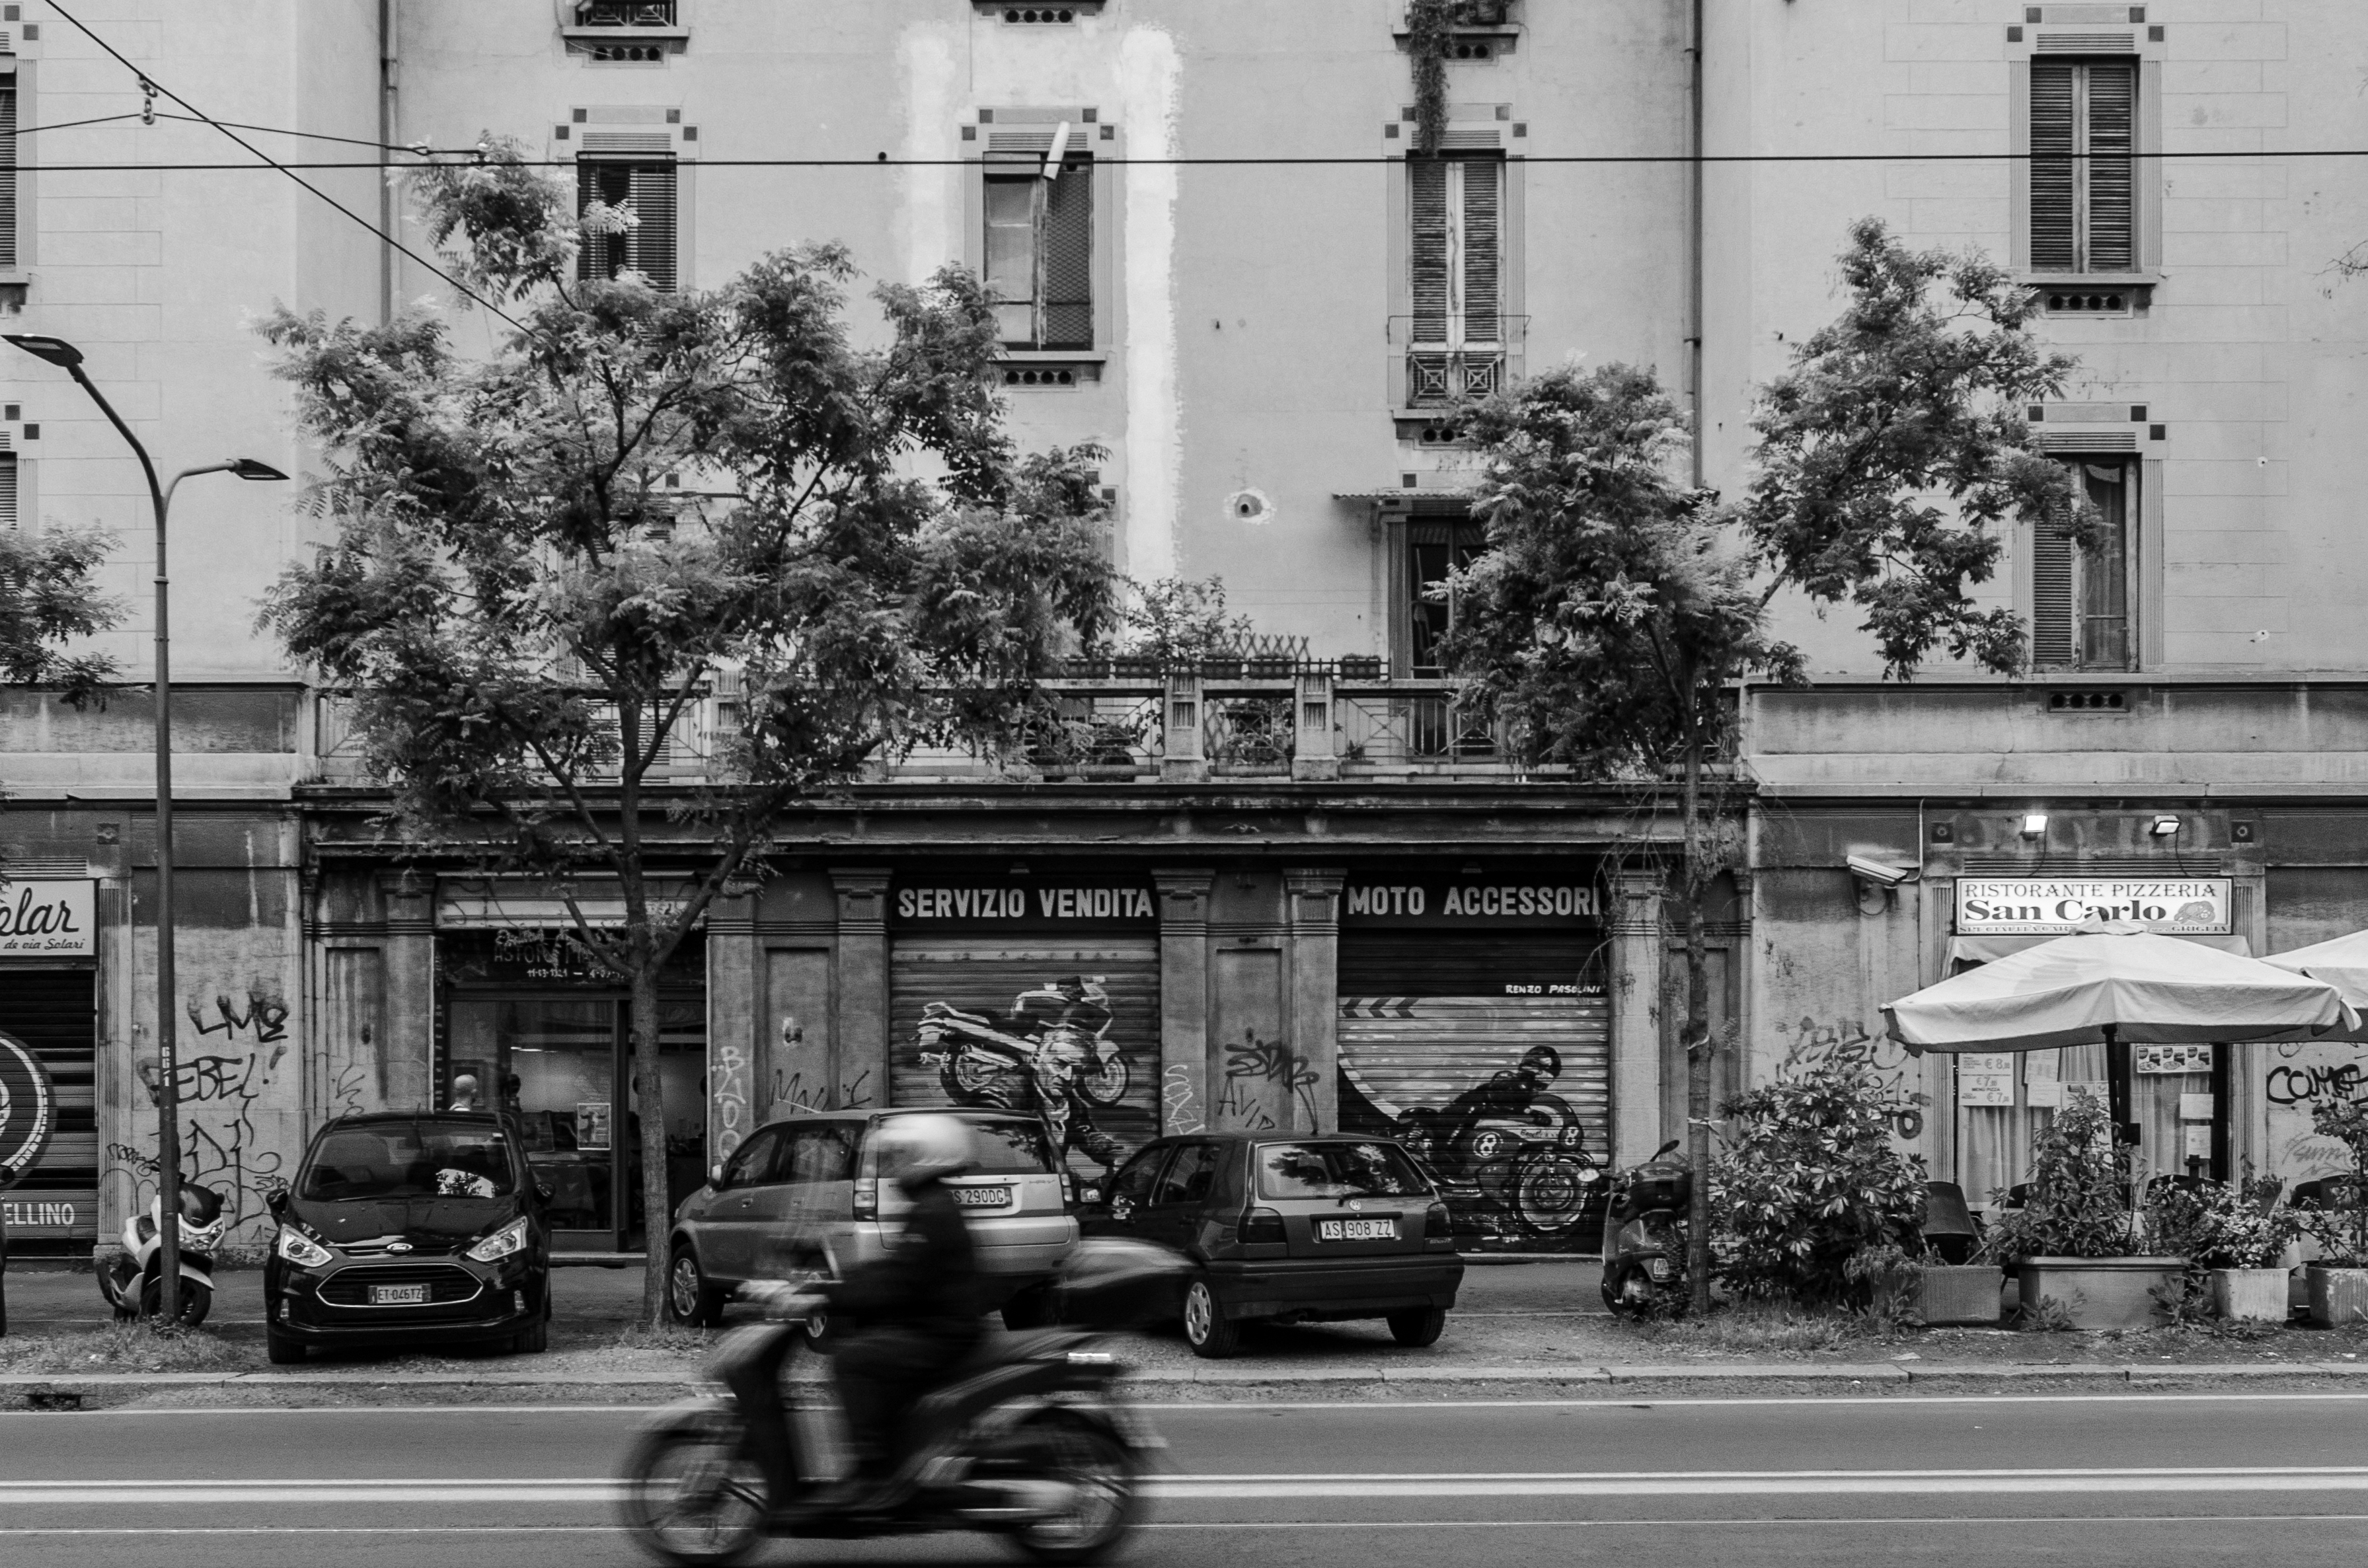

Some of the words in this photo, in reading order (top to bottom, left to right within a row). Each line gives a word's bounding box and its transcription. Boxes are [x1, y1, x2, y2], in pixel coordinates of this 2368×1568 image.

[1965, 884, 2103, 898] RISTORANTE
[2111, 883, 2218, 897] PIZZERIA
[898, 889, 1025, 918] SERVIZIO
[1039, 889, 1154, 918] VENDITA
[1348, 886, 1425, 915] MOTO
[1443, 886, 1599, 916] ACCESSORI
[1964, 899, 2044, 921] San
[2055, 899, 2167, 922] Carlo
[3, 939, 19, 950] de
[22, 939, 41, 949] via
[44, 938, 85, 950] Solari
[1506, 984, 1543, 994] RENZO
[965, 1189, 1005, 1204] 290DG
[1325, 1223, 1340, 1237] AS
[1347, 1222, 1372, 1236] 908
[1377, 1221, 1393, 1236] ZZ
